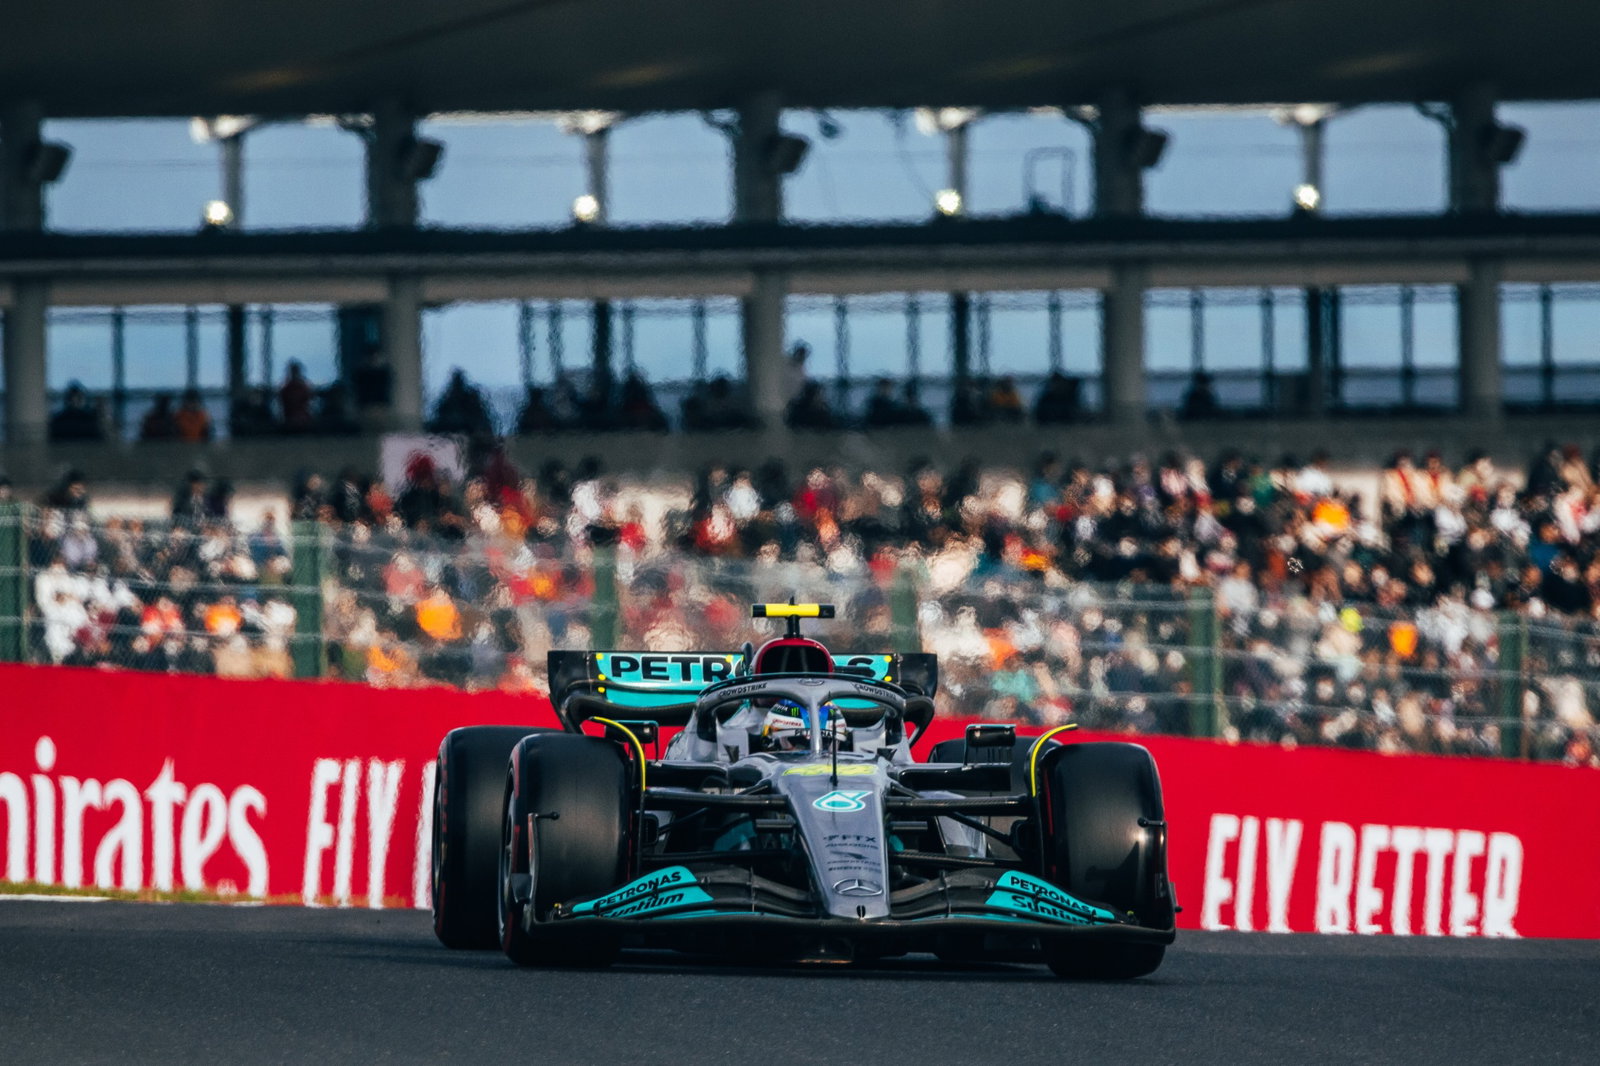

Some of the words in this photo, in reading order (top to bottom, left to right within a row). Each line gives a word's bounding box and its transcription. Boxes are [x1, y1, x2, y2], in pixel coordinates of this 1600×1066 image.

[611, 655, 874, 682] PETRS
[719, 682, 768, 696] CROWDSTRIKE
[599, 871, 682, 905] PETRONAS
[1010, 876, 1091, 914] PETRONAS
[1315, 821, 1524, 938] BETTER
